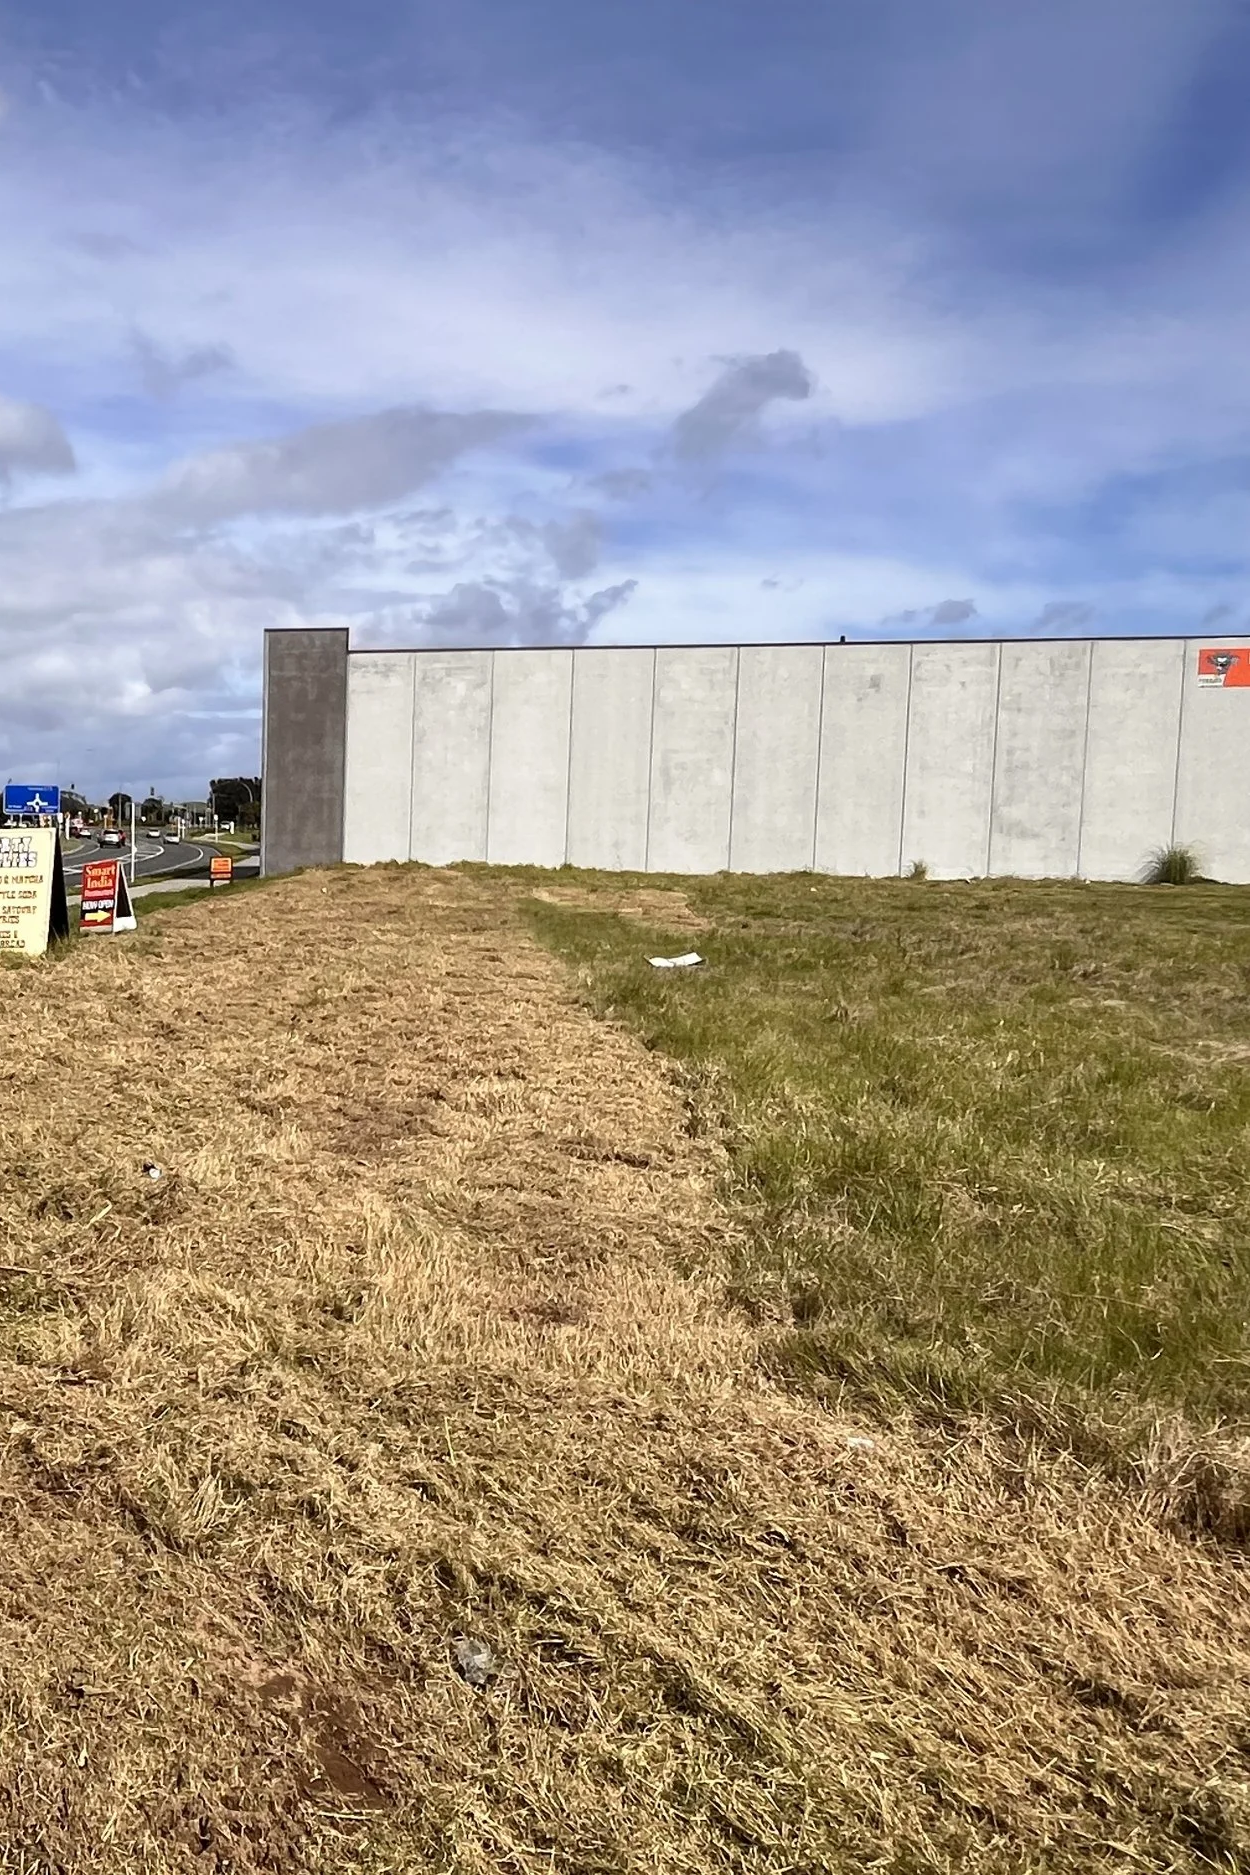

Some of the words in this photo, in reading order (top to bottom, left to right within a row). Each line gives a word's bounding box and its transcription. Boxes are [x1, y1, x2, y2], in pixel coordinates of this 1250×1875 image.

[85, 865, 116, 877] Smart
[86, 875, 113, 889] India
[82, 901, 98, 911] NOW
[98, 899, 114, 909] OPEN
